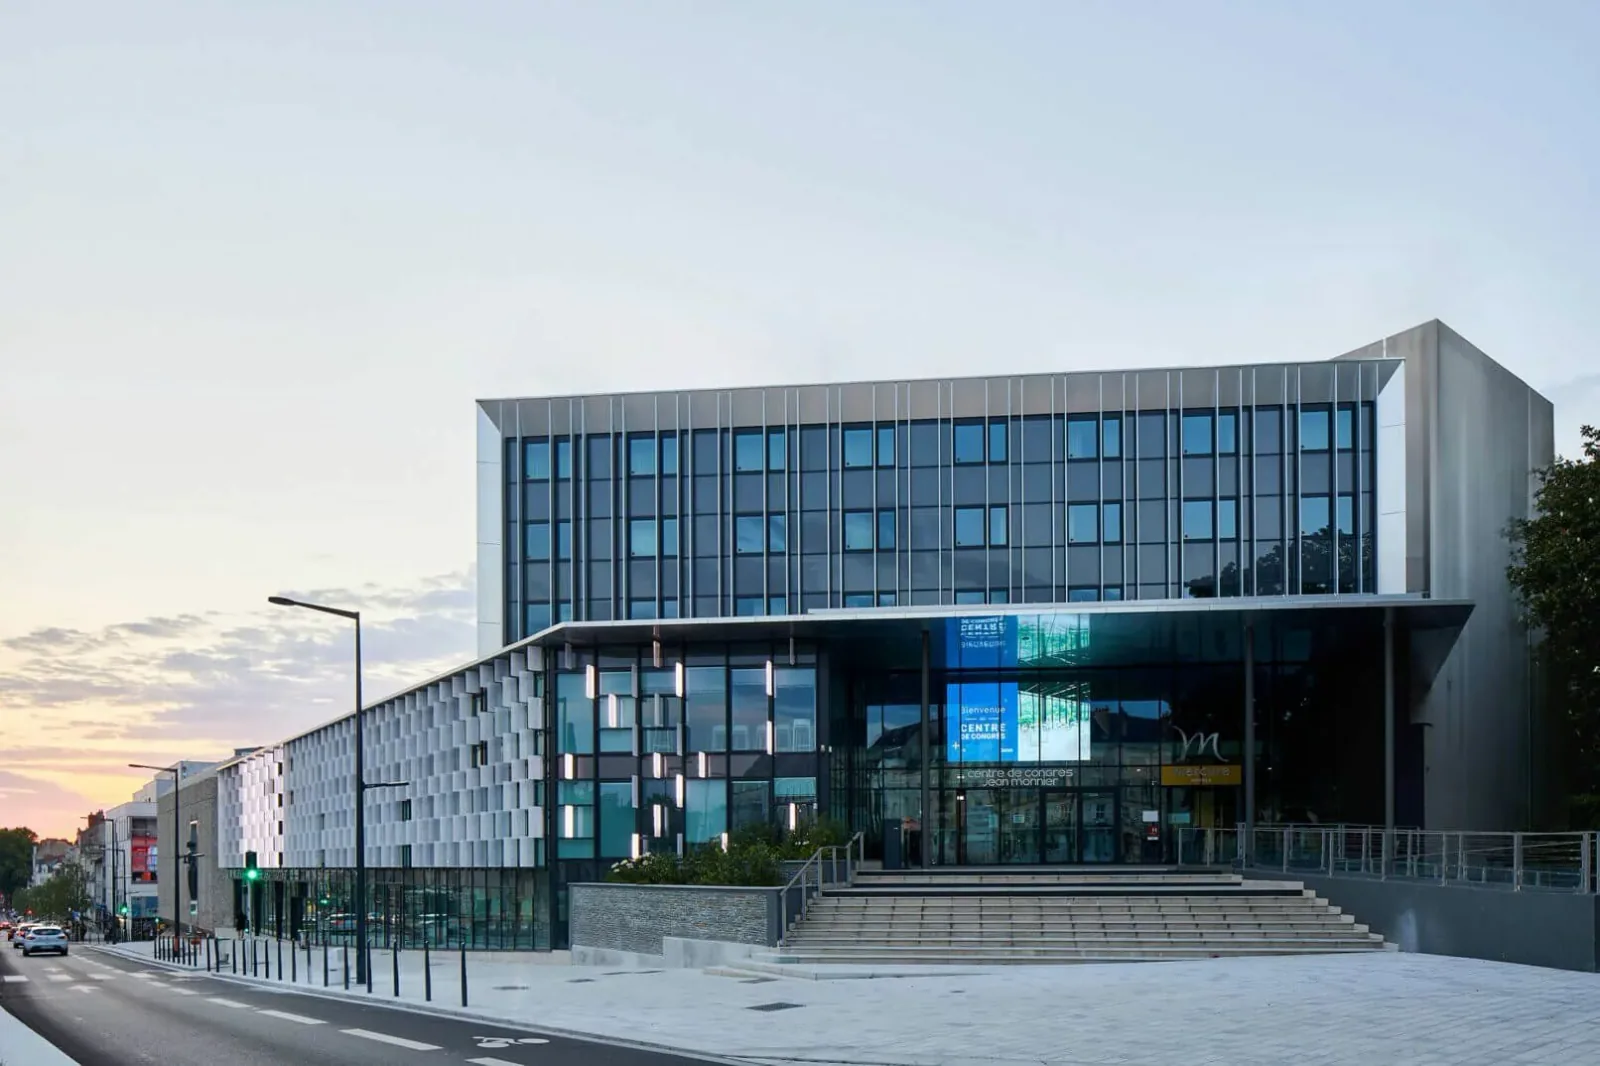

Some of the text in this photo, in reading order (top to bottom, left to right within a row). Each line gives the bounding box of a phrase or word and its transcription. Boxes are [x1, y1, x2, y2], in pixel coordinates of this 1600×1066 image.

[961, 723, 1006, 732] CENTRE
[967, 768, 1005, 778] centre
[1006, 768, 1022, 778] de
[1011, 777, 1058, 786] monnier
